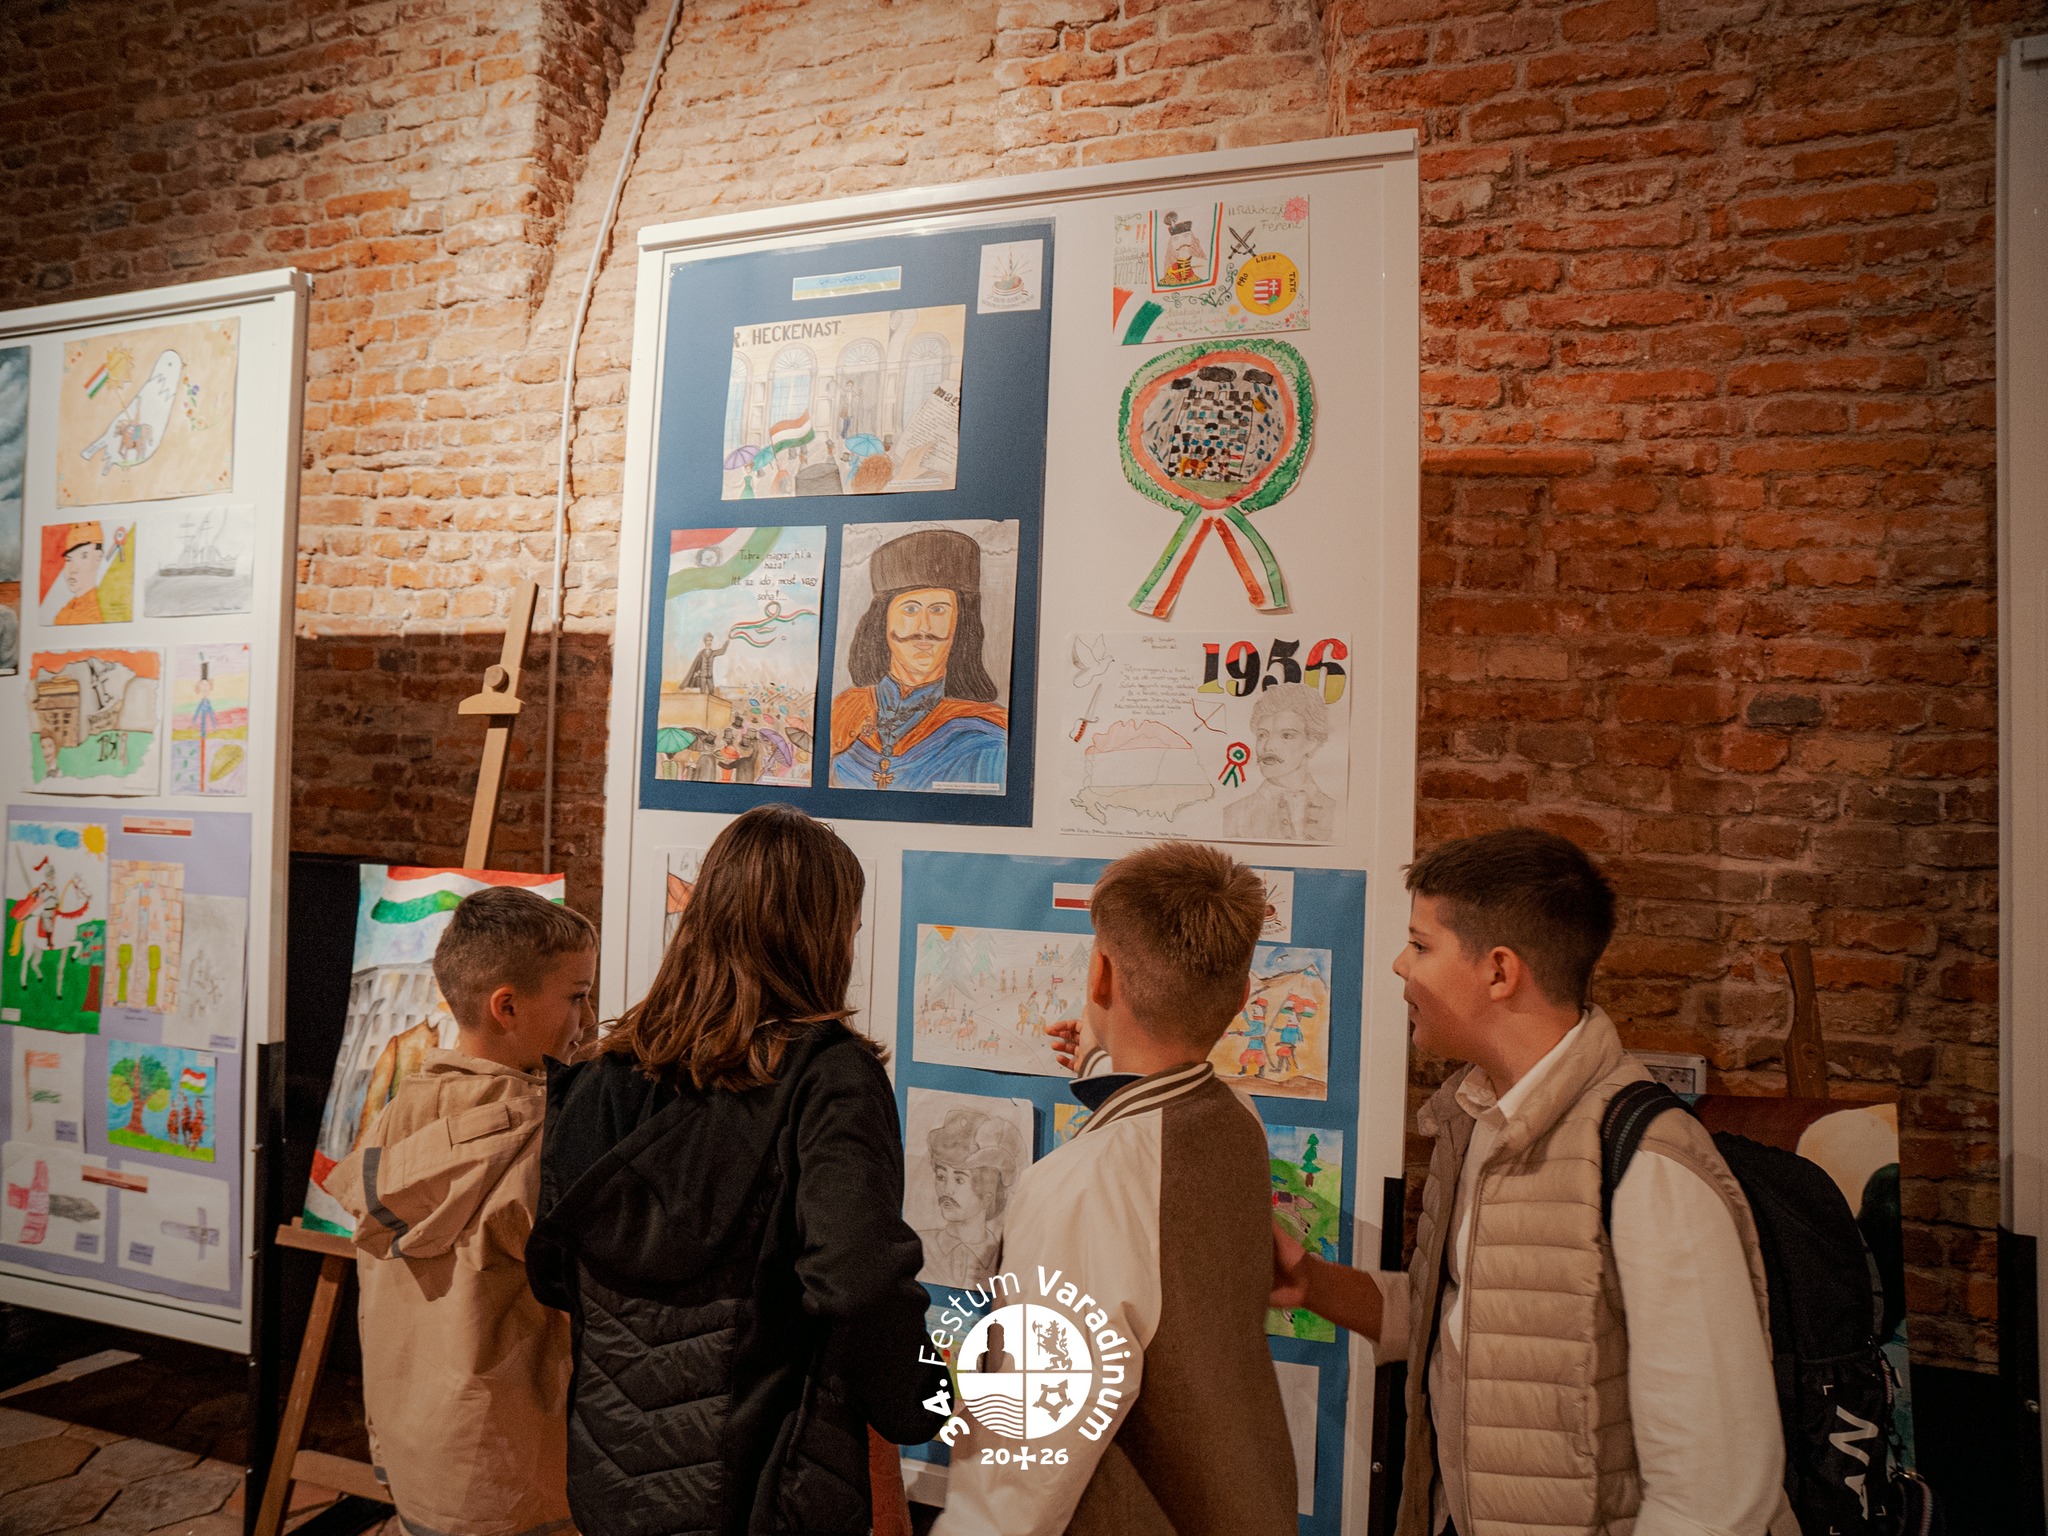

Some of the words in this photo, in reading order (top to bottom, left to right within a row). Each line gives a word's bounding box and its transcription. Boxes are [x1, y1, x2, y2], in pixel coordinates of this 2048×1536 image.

[1237, 273, 1249, 287] PRO
[933, 385, 961, 407] mag
[778, 574, 796, 585] most
[801, 577, 818, 587] vagy
[1197, 638, 1348, 705] 1956
